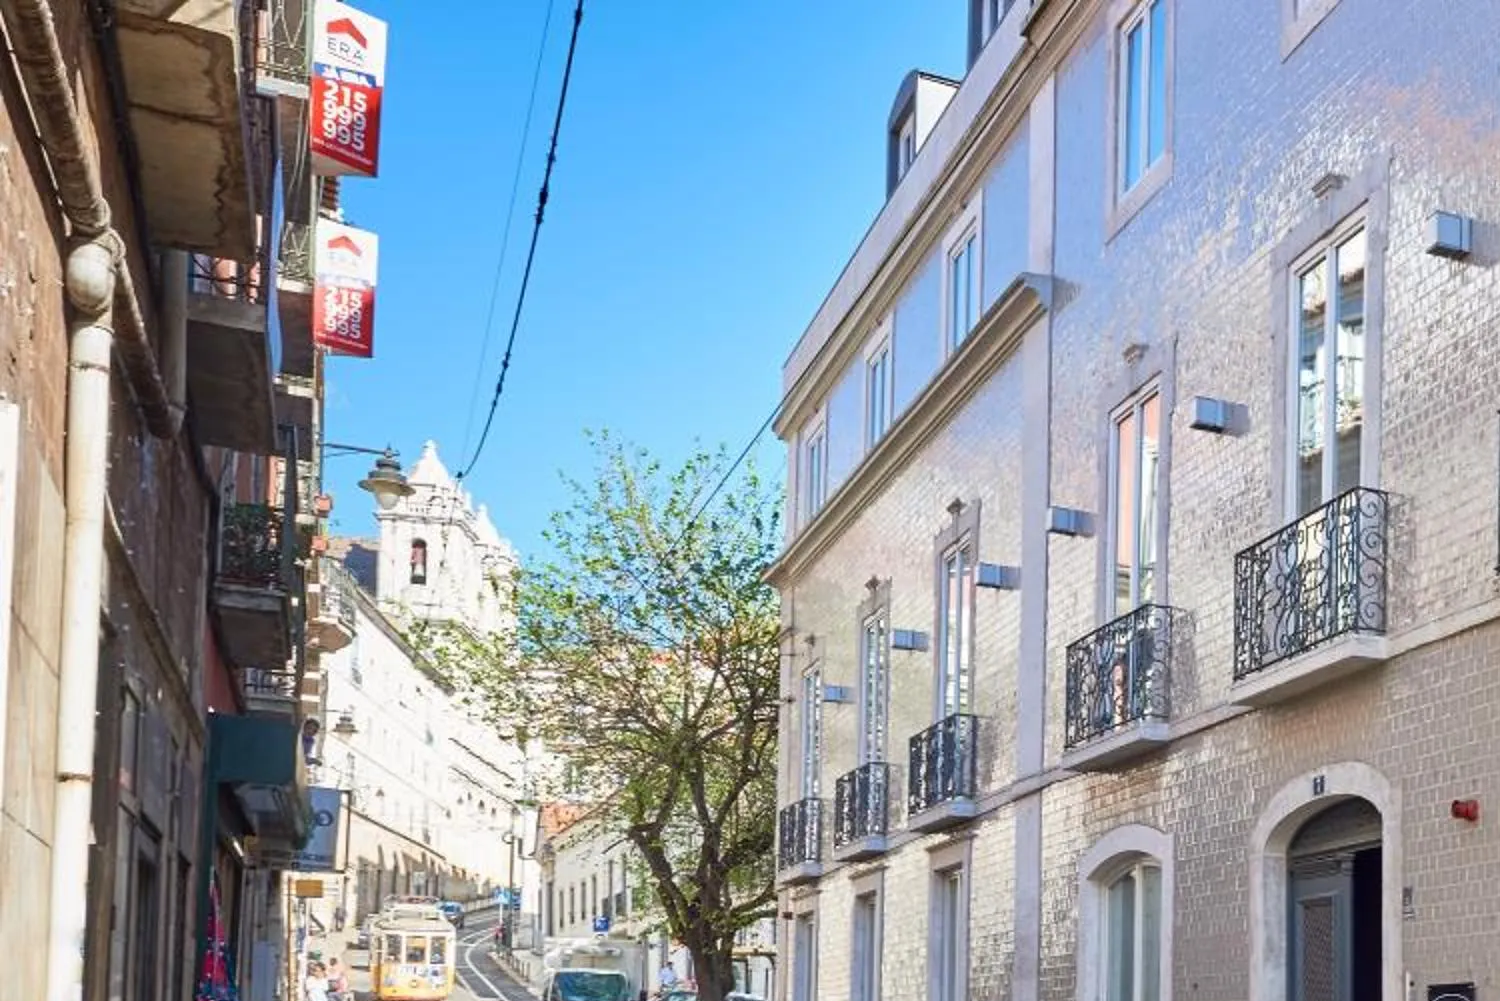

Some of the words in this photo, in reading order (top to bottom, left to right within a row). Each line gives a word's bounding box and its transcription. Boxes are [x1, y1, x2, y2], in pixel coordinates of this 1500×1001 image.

[327, 36, 366, 61] ERA
[323, 80, 368, 113] 215
[322, 118, 366, 152] 995
[324, 287, 362, 309] 215
[324, 317, 361, 339] 995
